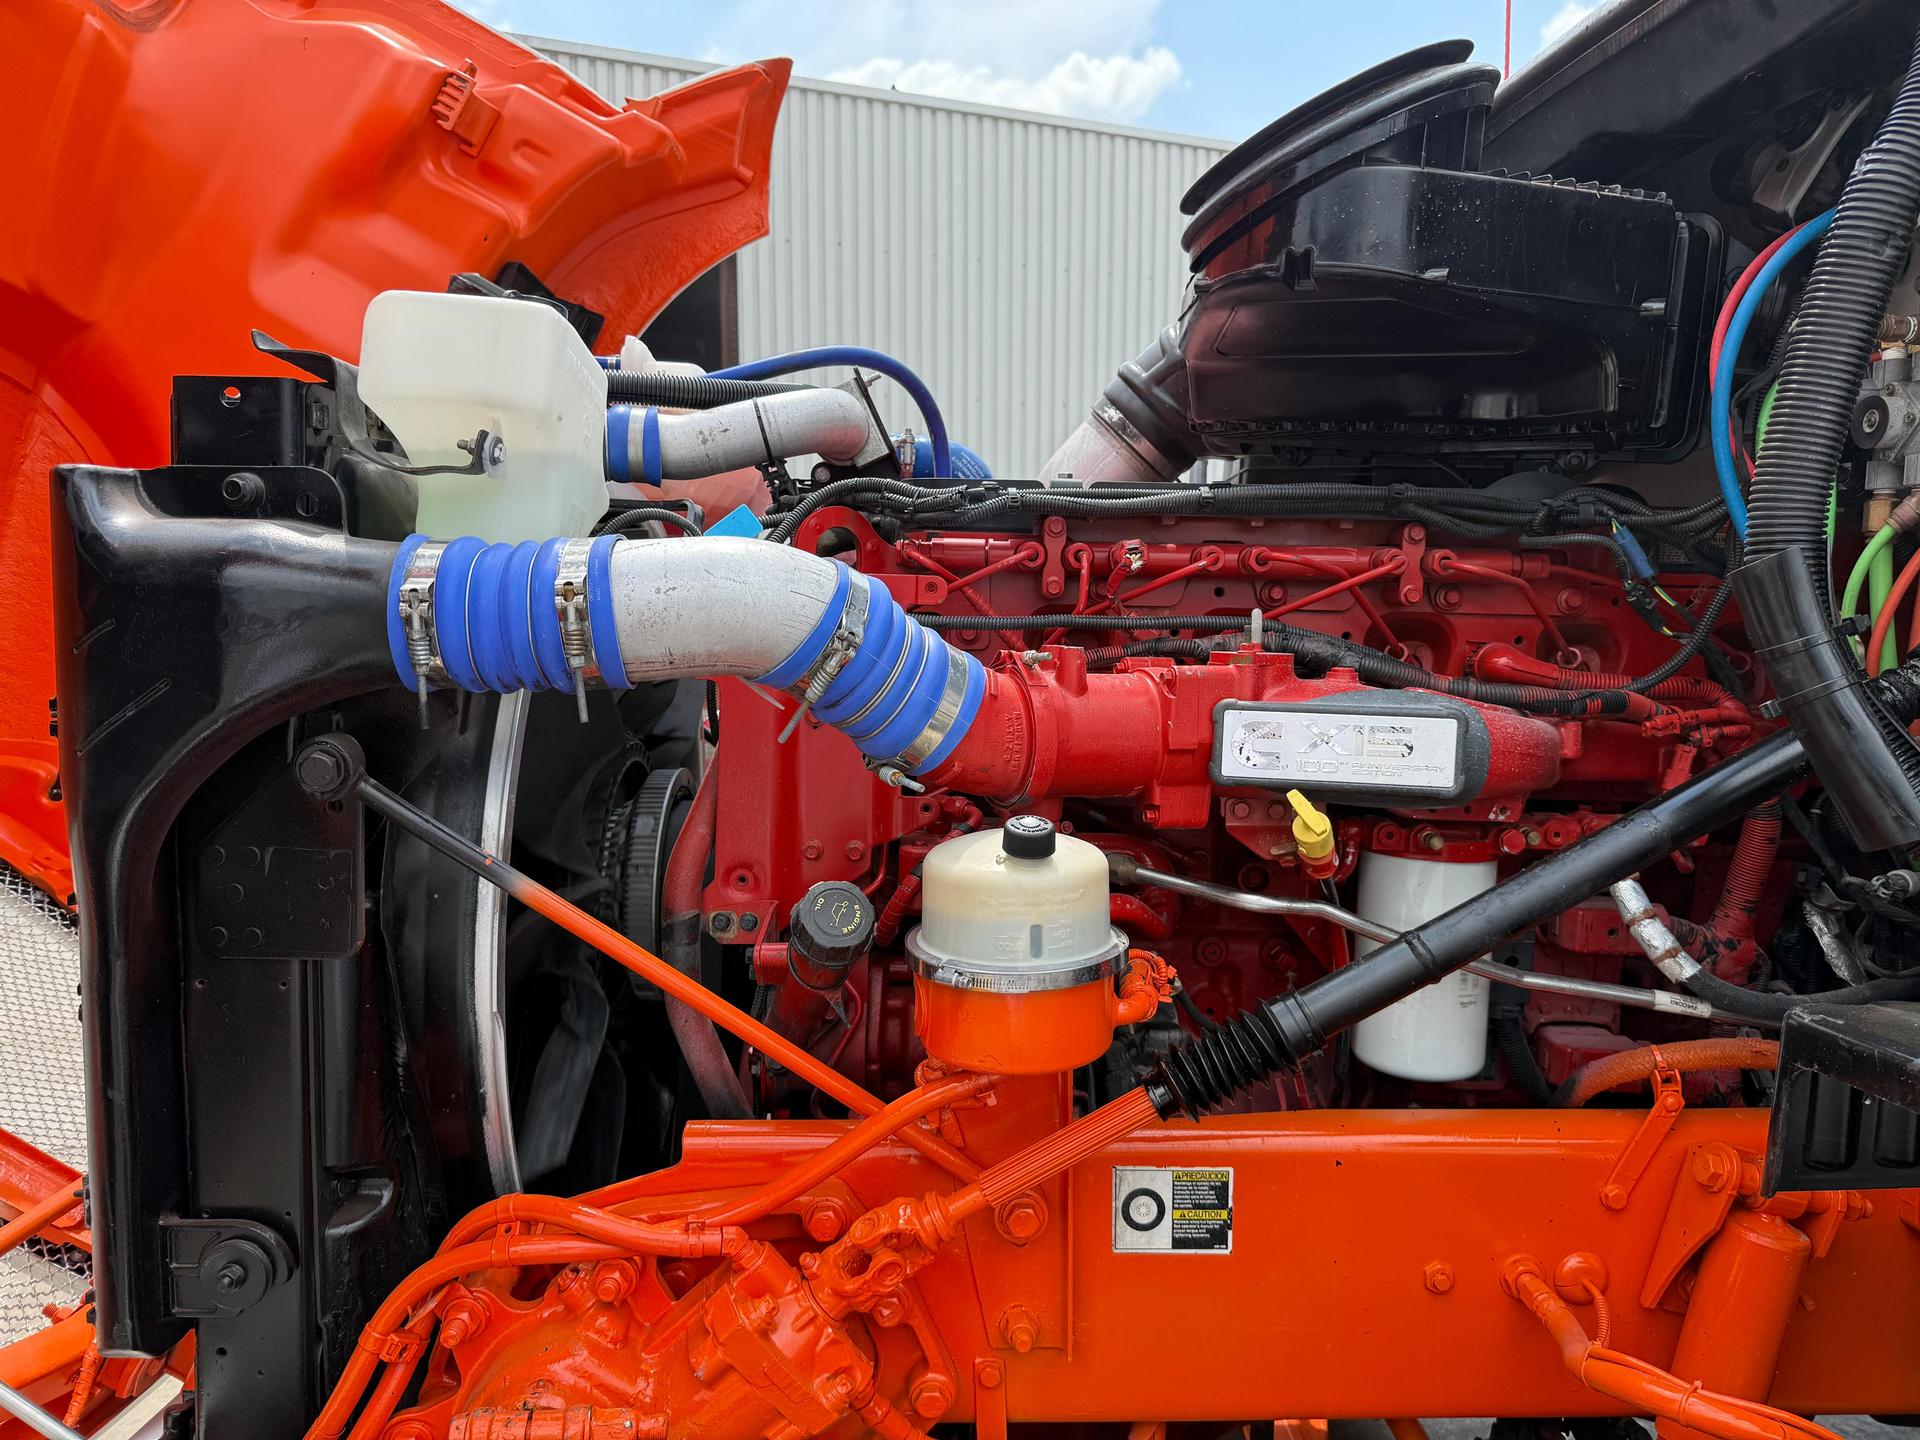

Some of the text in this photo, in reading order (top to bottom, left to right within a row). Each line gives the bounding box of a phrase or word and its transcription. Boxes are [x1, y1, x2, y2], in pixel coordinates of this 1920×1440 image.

[1296, 721, 1414, 758] X15
[1351, 762, 1447, 774] ANNIVERSARY
[1351, 768, 1404, 777] EDITION
[815, 897, 825, 911] OIL
[841, 904, 862, 935] ENGINE
[1052, 928, 1072, 939] HOT
[996, 940, 1025, 951] COLD
[1182, 1171, 1228, 1180] PRECAUCION
[1187, 1210, 1222, 1218] CAUTION
